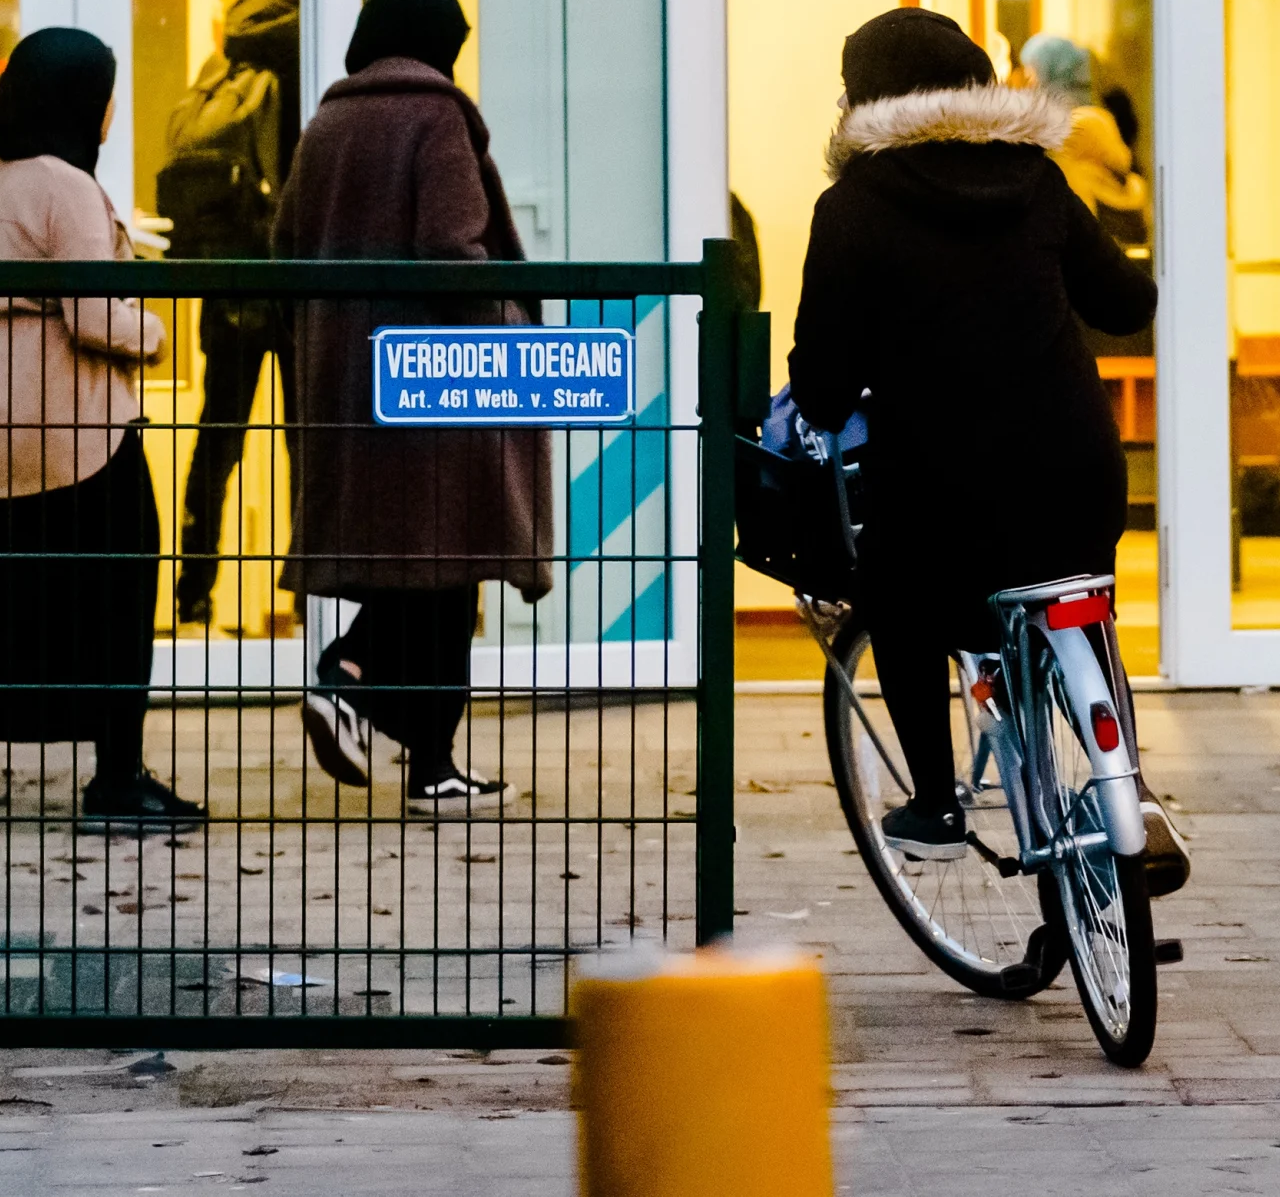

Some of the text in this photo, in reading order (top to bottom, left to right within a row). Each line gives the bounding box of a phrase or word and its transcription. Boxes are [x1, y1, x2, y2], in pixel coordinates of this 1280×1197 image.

[385, 342, 622, 379] VERBODEN TOEGANG
[398, 387, 611, 409] Art. 461 Wetb. v. Strafr.
